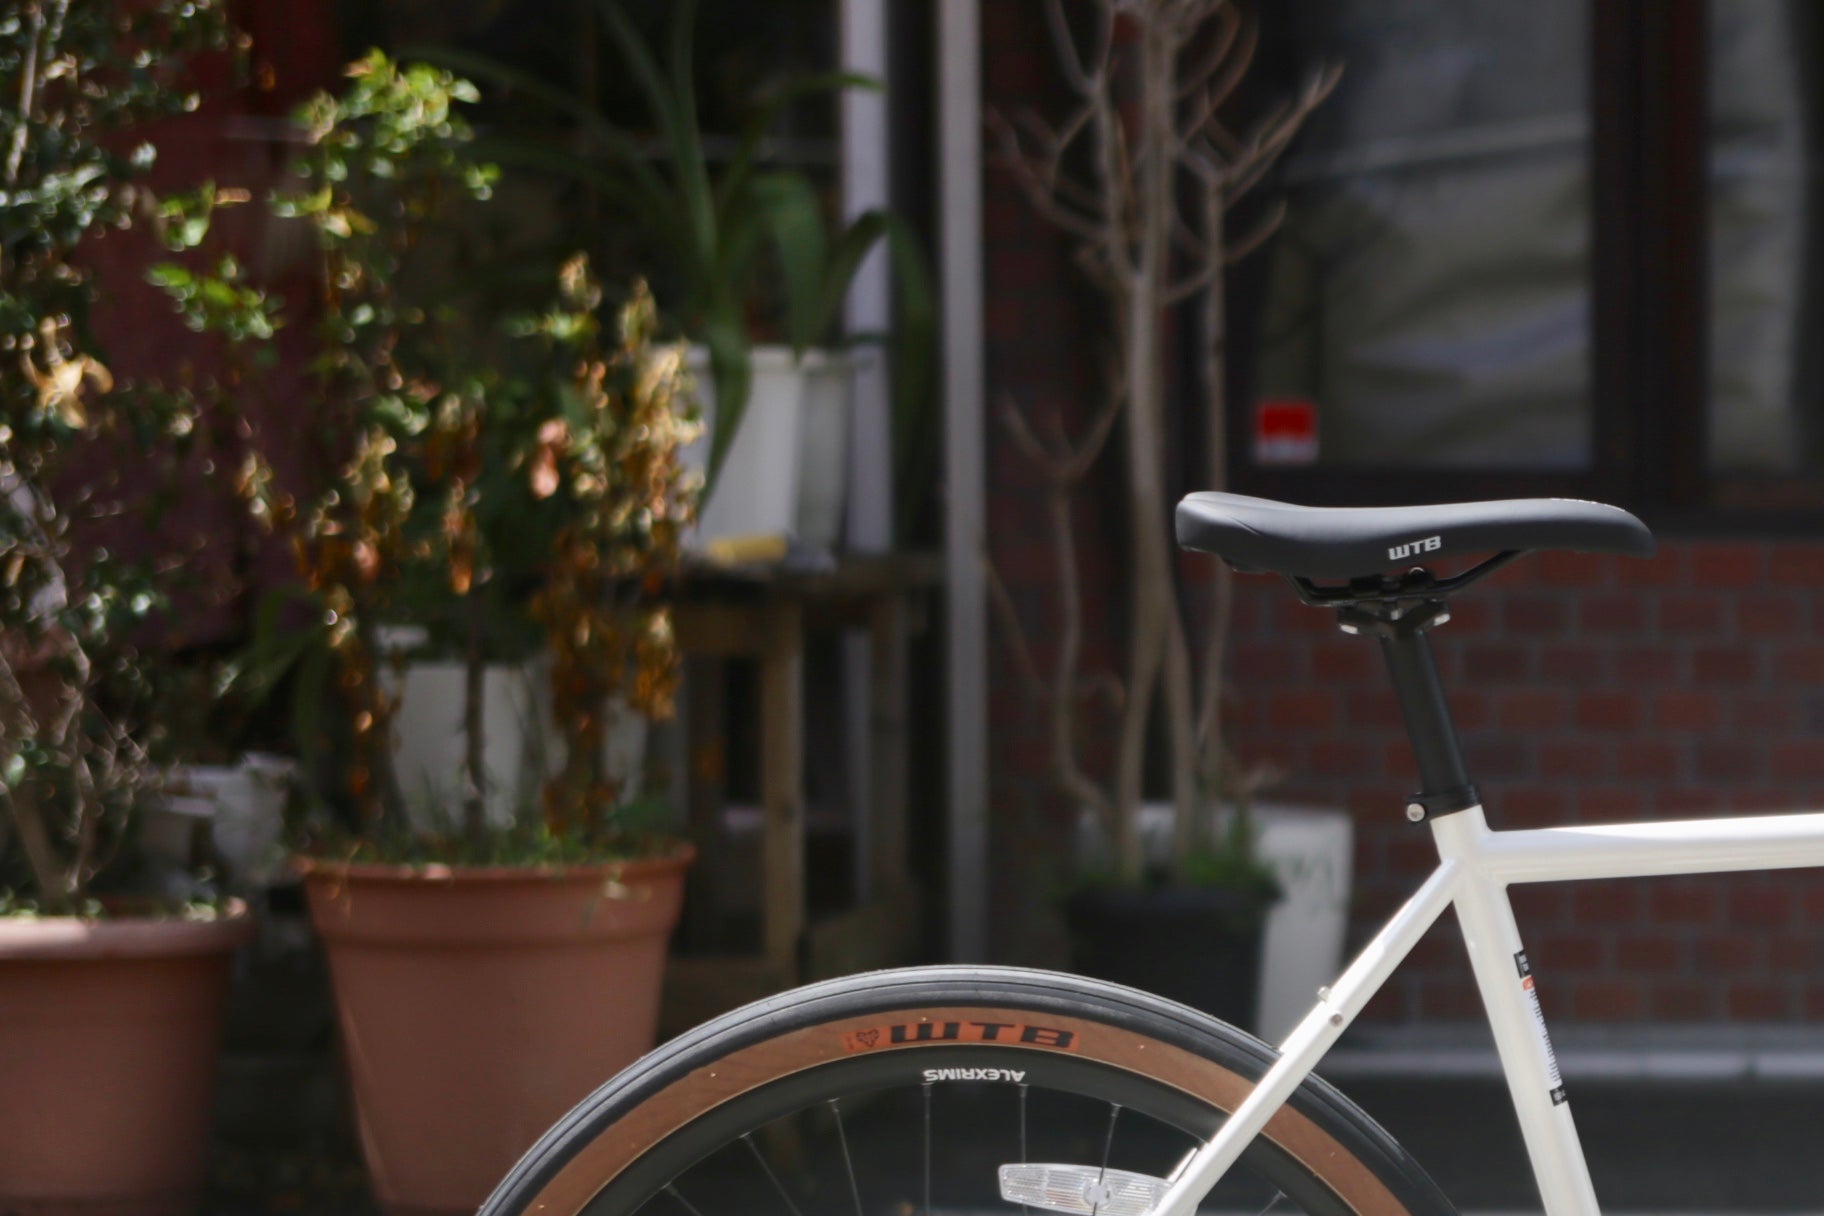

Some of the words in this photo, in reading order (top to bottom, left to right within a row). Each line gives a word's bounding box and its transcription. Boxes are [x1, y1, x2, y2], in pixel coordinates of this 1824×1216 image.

[1388, 535, 1442, 560] WTB
[889, 1022, 1076, 1048] WTB
[922, 1068, 1027, 1083] ALEXRIMS
